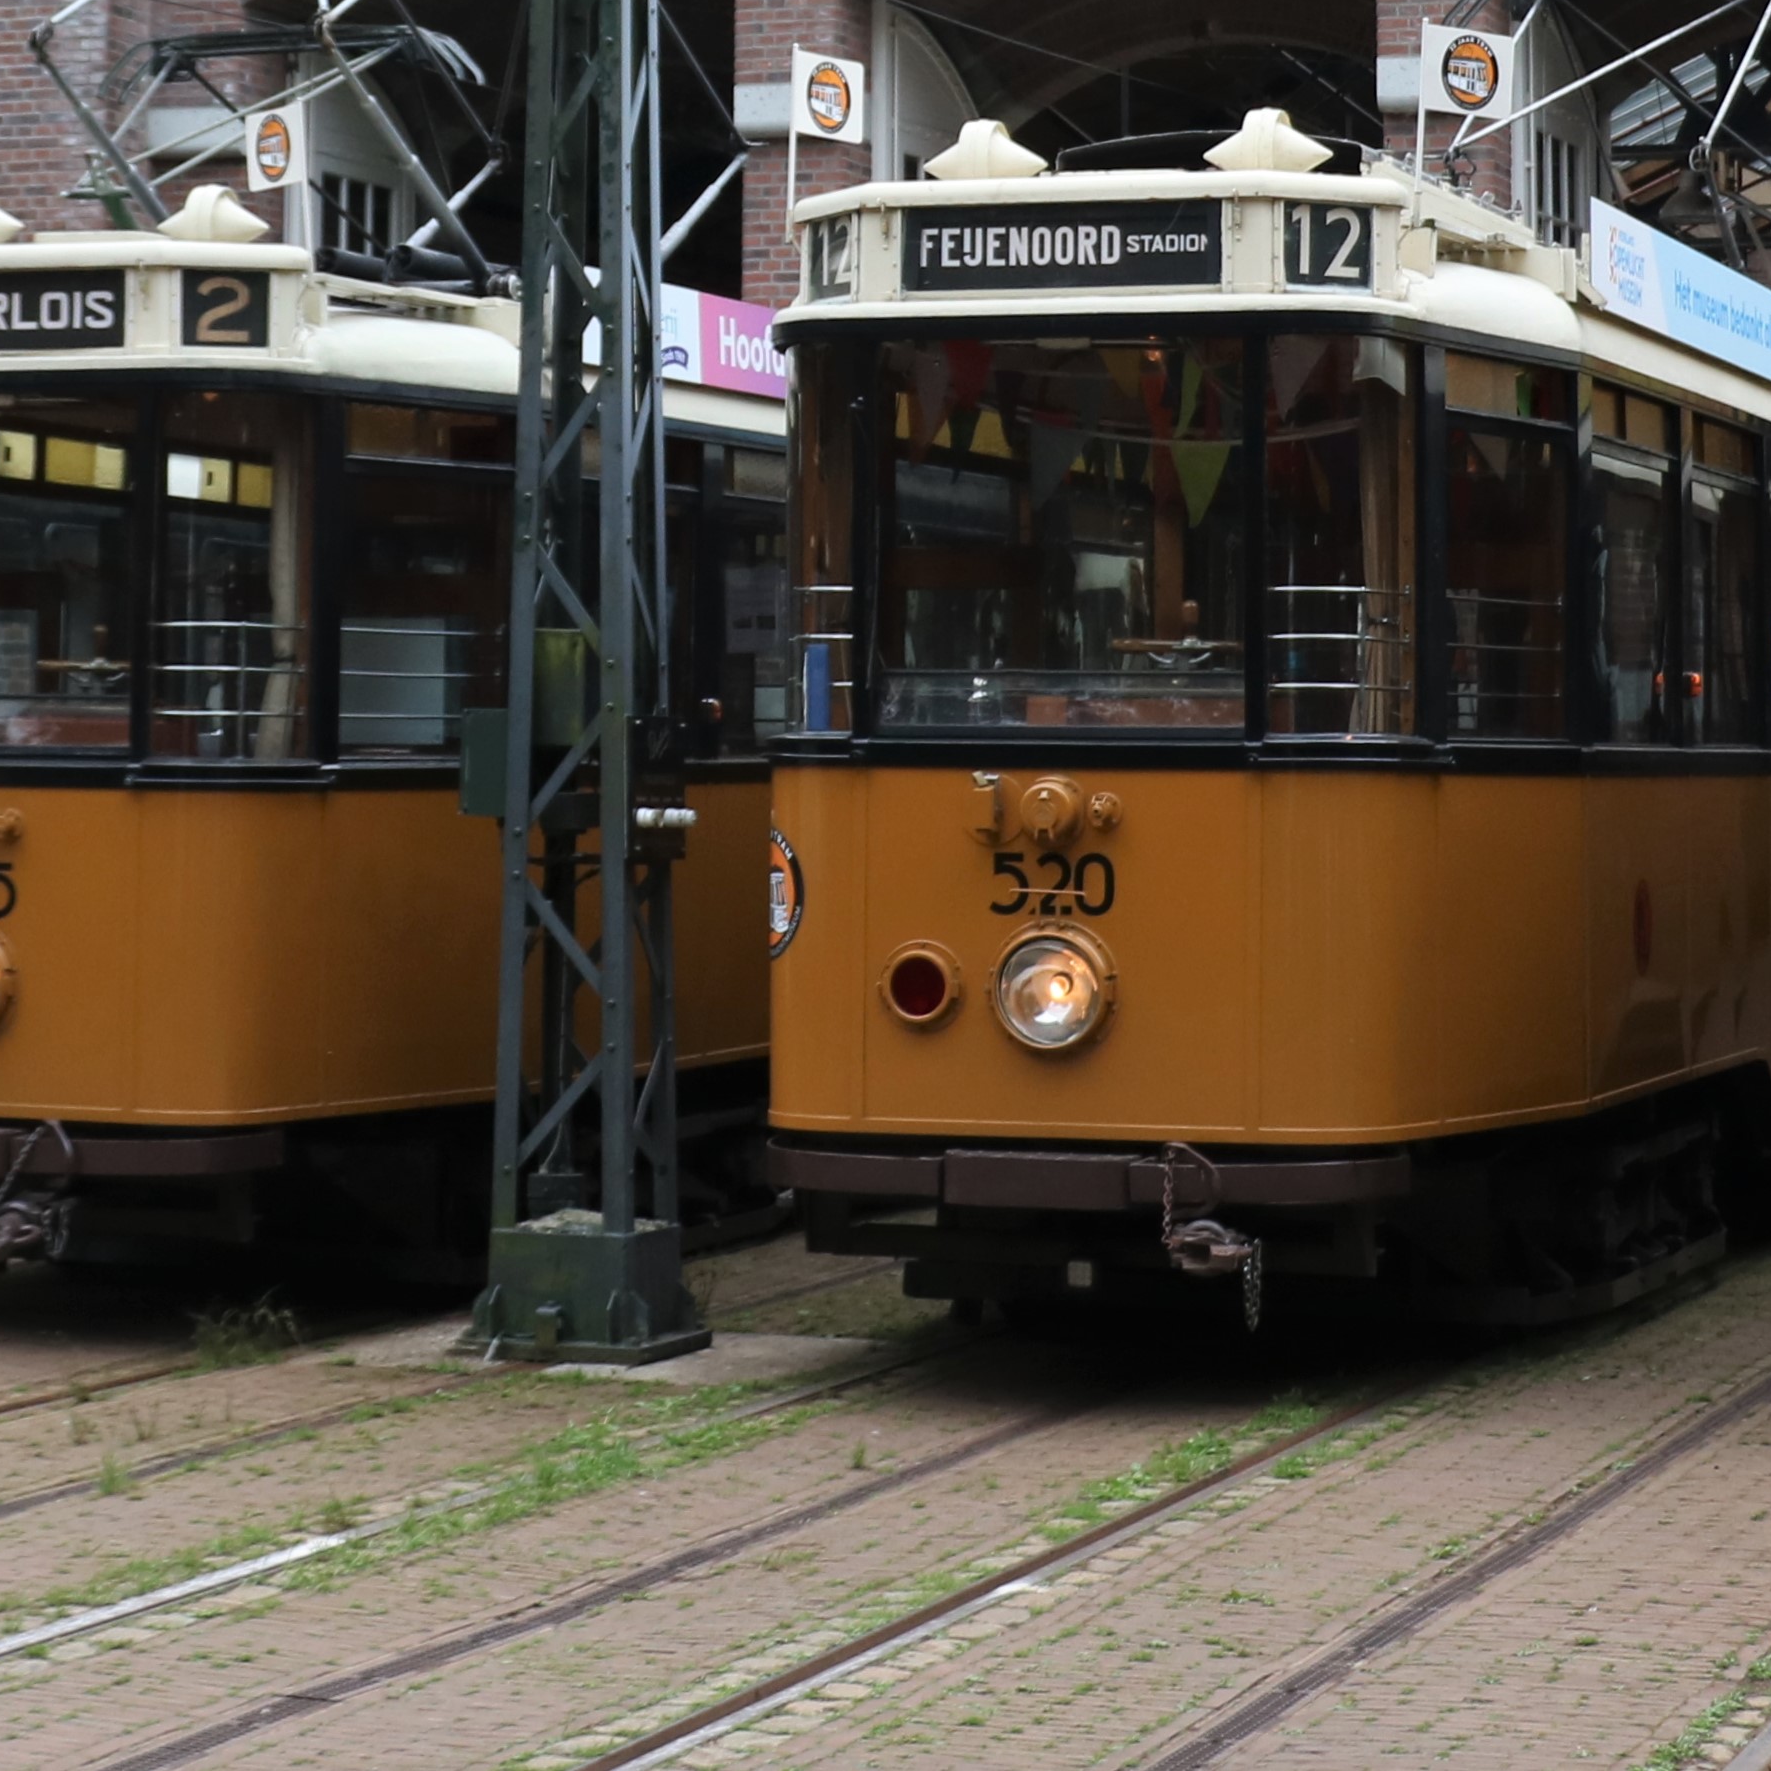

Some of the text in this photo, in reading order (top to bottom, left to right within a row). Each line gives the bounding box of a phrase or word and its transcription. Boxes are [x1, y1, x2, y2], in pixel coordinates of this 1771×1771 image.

[817, 215, 852, 288] 12
[1290, 203, 1362, 280] 12
[194, 277, 252, 344] 2
[1674, 269, 1691, 313] Het
[1694, 289, 1729, 330] museum
[1730, 295, 1763, 346] bedankt
[989, 851, 1117, 918] 520
